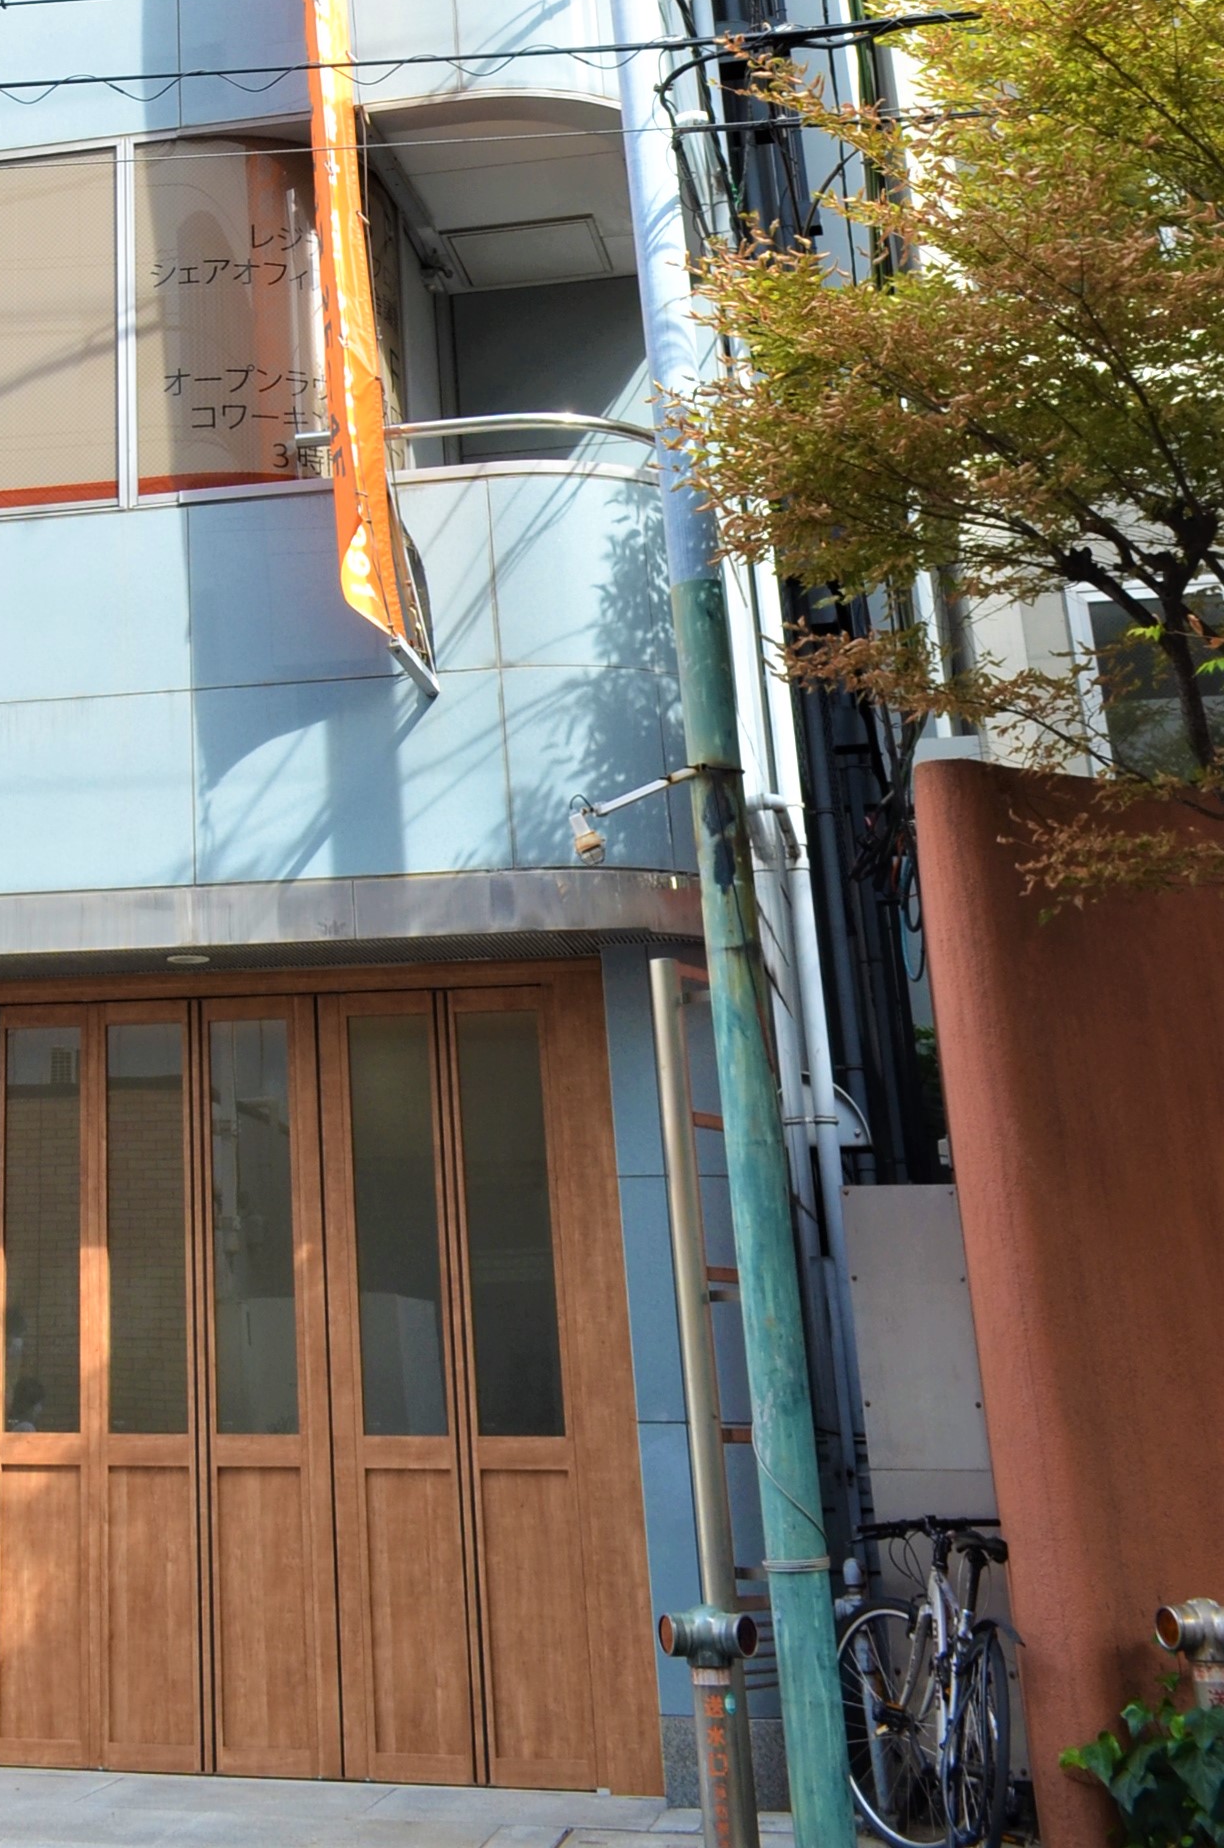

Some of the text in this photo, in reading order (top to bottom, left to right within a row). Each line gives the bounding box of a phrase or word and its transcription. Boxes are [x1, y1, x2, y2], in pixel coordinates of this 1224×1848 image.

[149, 258, 321, 292] シェアオフィ
